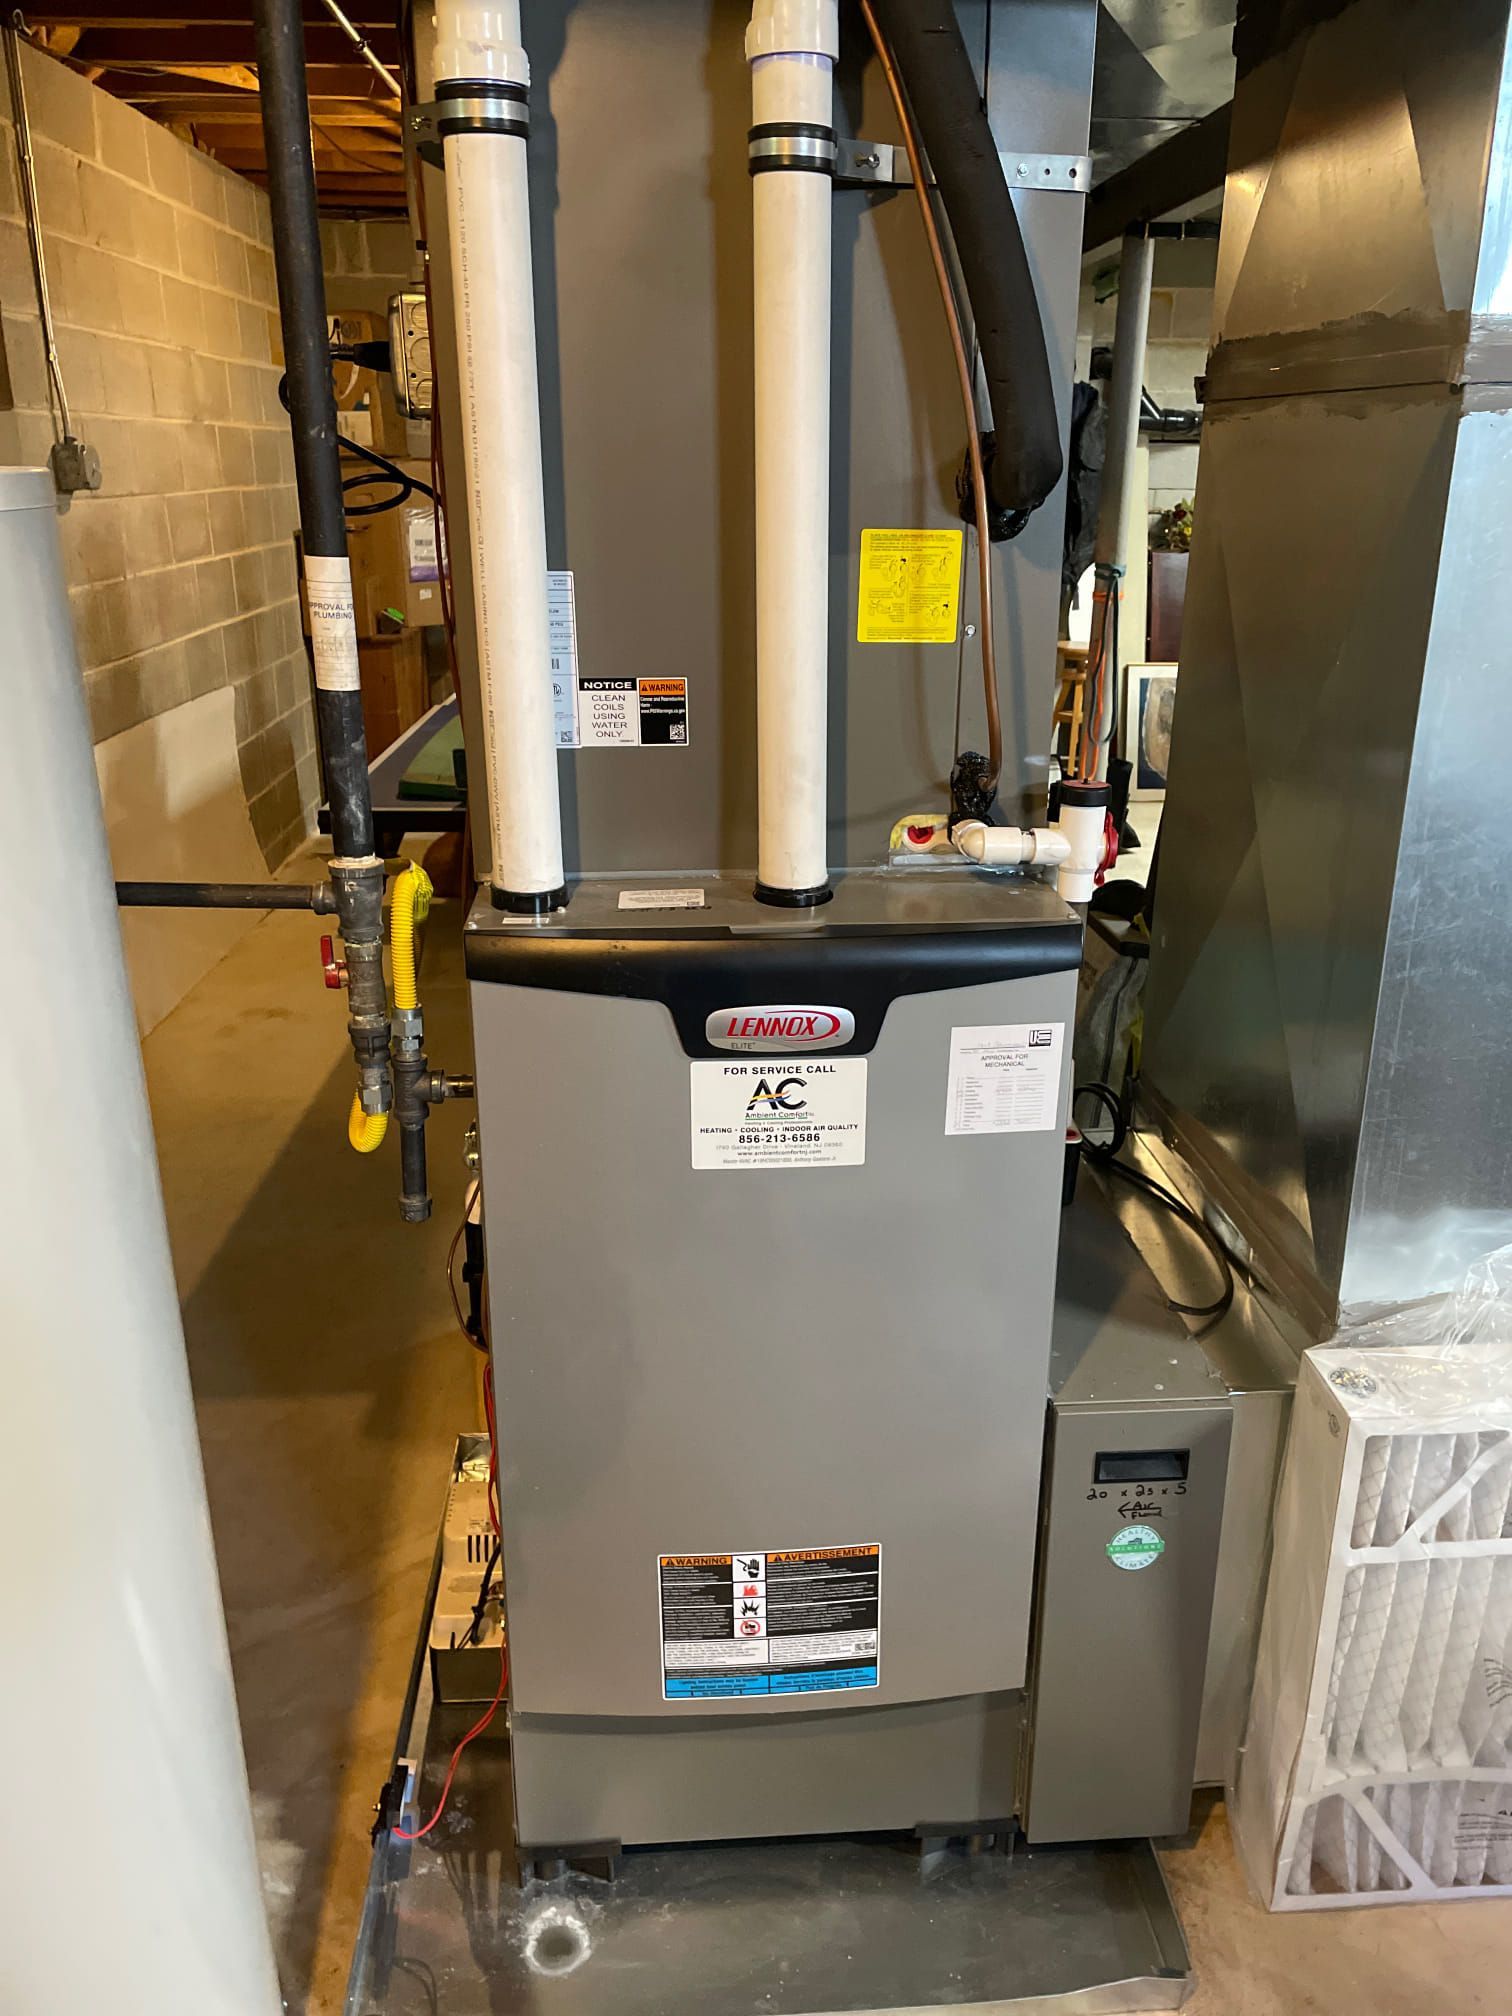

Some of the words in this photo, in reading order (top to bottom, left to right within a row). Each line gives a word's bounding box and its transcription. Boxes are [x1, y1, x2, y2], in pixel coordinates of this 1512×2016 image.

[313, 611, 353, 620] PLUMBING
[584, 681, 632, 690] NOTICE
[649, 684, 684, 692] WARNING
[592, 694, 626, 702] CLEAN
[593, 703, 625, 711] COILS
[593, 712, 626, 721] USING
[592, 721, 628, 729] WATER
[596, 730, 623, 738] ONLY
[726, 1016, 819, 1038] LENNOX
[724, 1067, 748, 1076] FOR
[752, 1066, 802, 1075] SERVICE
[806, 1065, 836, 1074] CALL
[746, 1077, 808, 1111] AC
[745, 1111, 777, 1120] Ambient
[778, 1111, 809, 1120] Comfort
[738, 1133, 821, 1144] 856-213-6586
[1086, 1488, 1108, 1501] 20
[1174, 1482, 1188, 1495] 5
[1116, 1527, 1157, 1544] HEALTHY
[784, 1547, 873, 1561] AVERTISSEMENT
[675, 1558, 727, 1566] WARNING
[1115, 1552, 1155, 1569] CLIMATE
